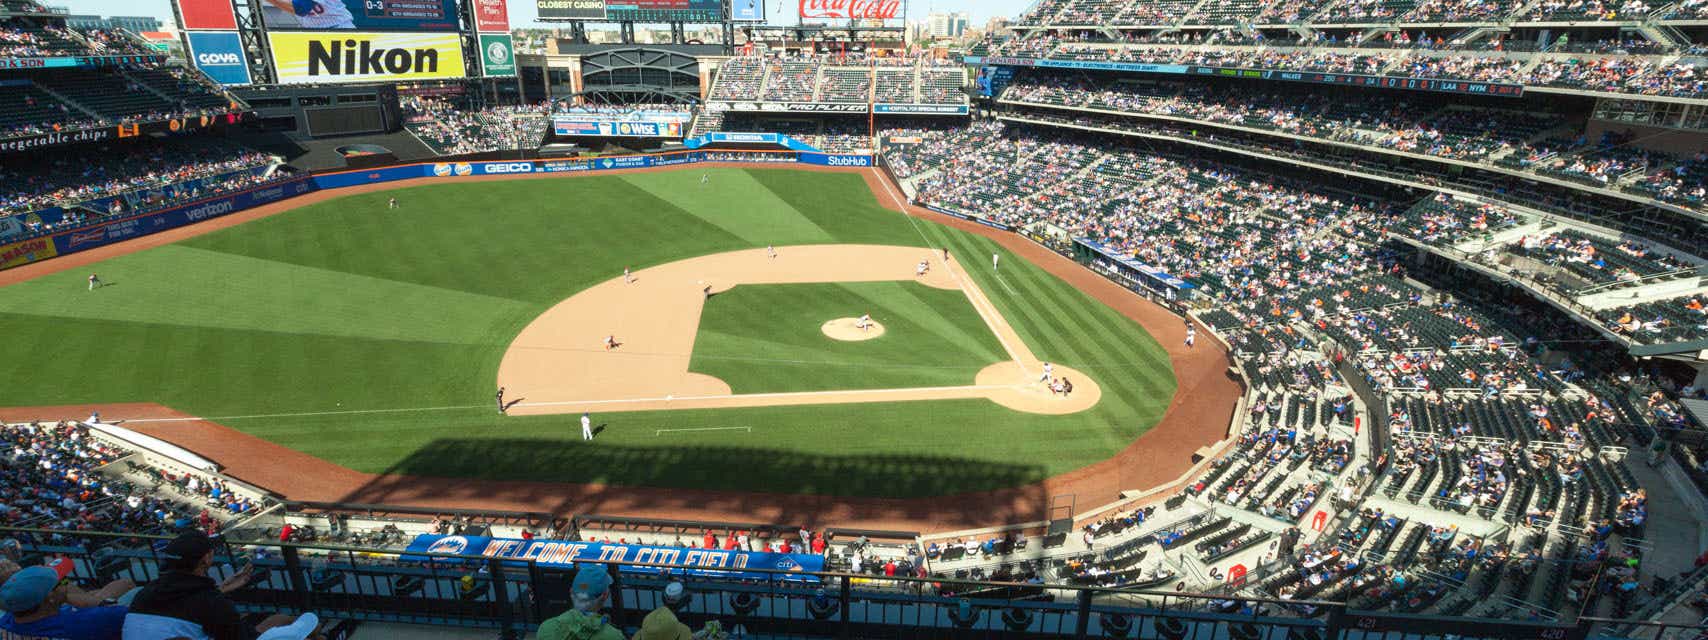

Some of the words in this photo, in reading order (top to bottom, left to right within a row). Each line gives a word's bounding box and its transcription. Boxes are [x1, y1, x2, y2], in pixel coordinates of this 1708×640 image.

[199, 53, 240, 63] GOYA
[308, 39, 439, 76] Nikon
[816, 104, 867, 112] PLAYER
[631, 123, 656, 134] WISE
[1, 133, 69, 151] vegetable
[74, 130, 107, 145] chips
[828, 156, 867, 165] StubHub
[485, 163, 532, 173] GEICO
[186, 200, 232, 221] verizon
[482, 539, 587, 564] WELCOME
[599, 545, 628, 565] TO
[632, 547, 684, 569] CITI
[681, 551, 750, 574] FIELD
[777, 560, 794, 569] citi
